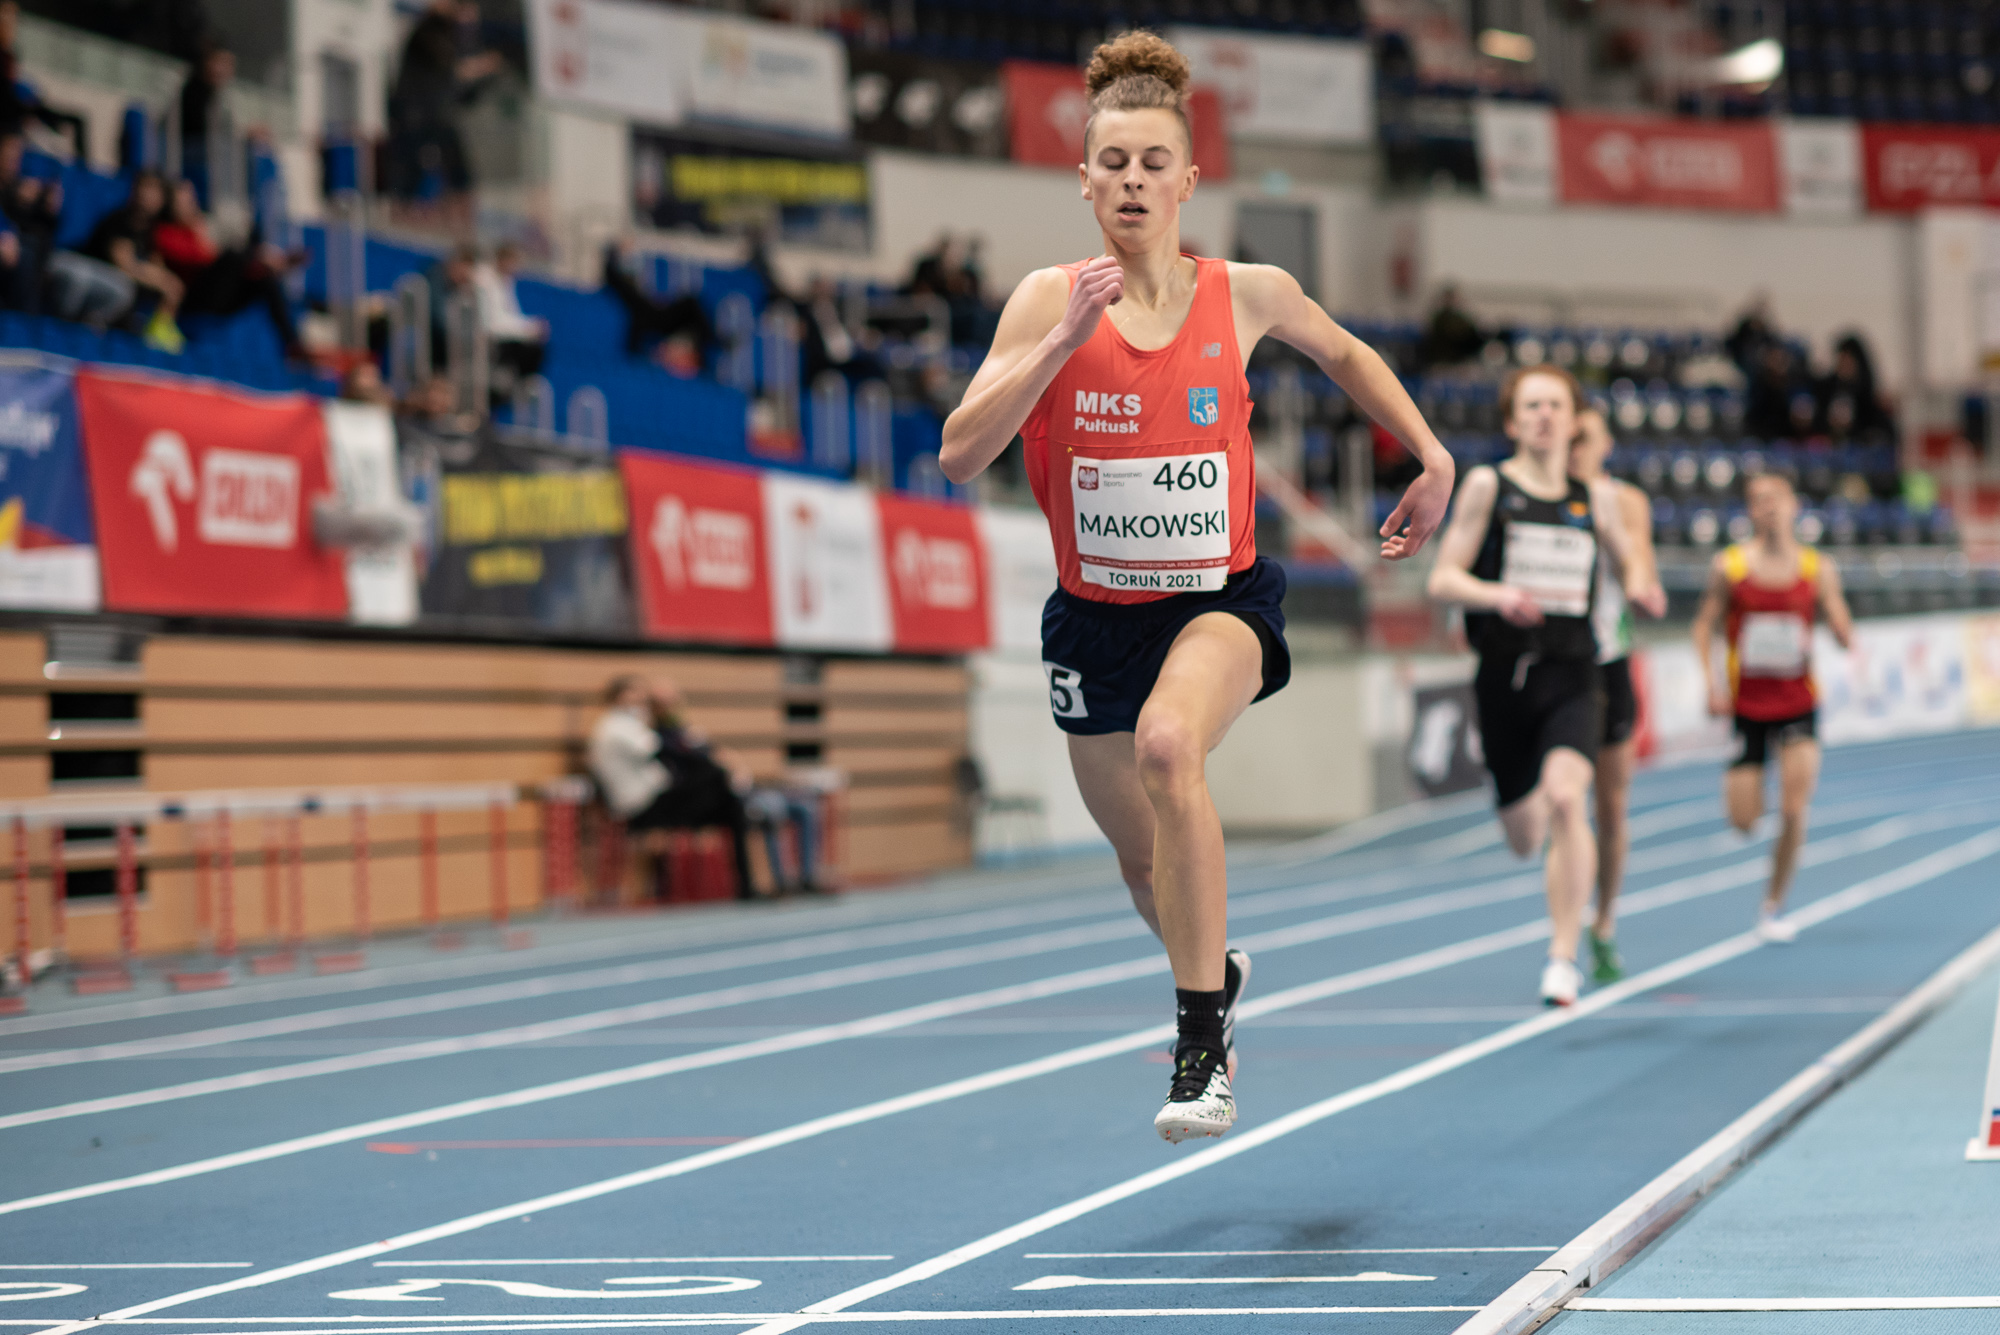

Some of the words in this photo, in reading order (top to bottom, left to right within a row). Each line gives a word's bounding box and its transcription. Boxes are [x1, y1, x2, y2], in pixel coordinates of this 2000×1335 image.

[1075, 390, 1142, 416] MKS
[1074, 416, 1140, 434] Pułtusk
[1153, 459, 1218, 492] 460
[1079, 509, 1226, 539] MAKOWSKI
[1109, 571, 1160, 587] TORUŃ
[1166, 574, 1202, 588] 2021
[1051, 668, 1073, 713] 5
